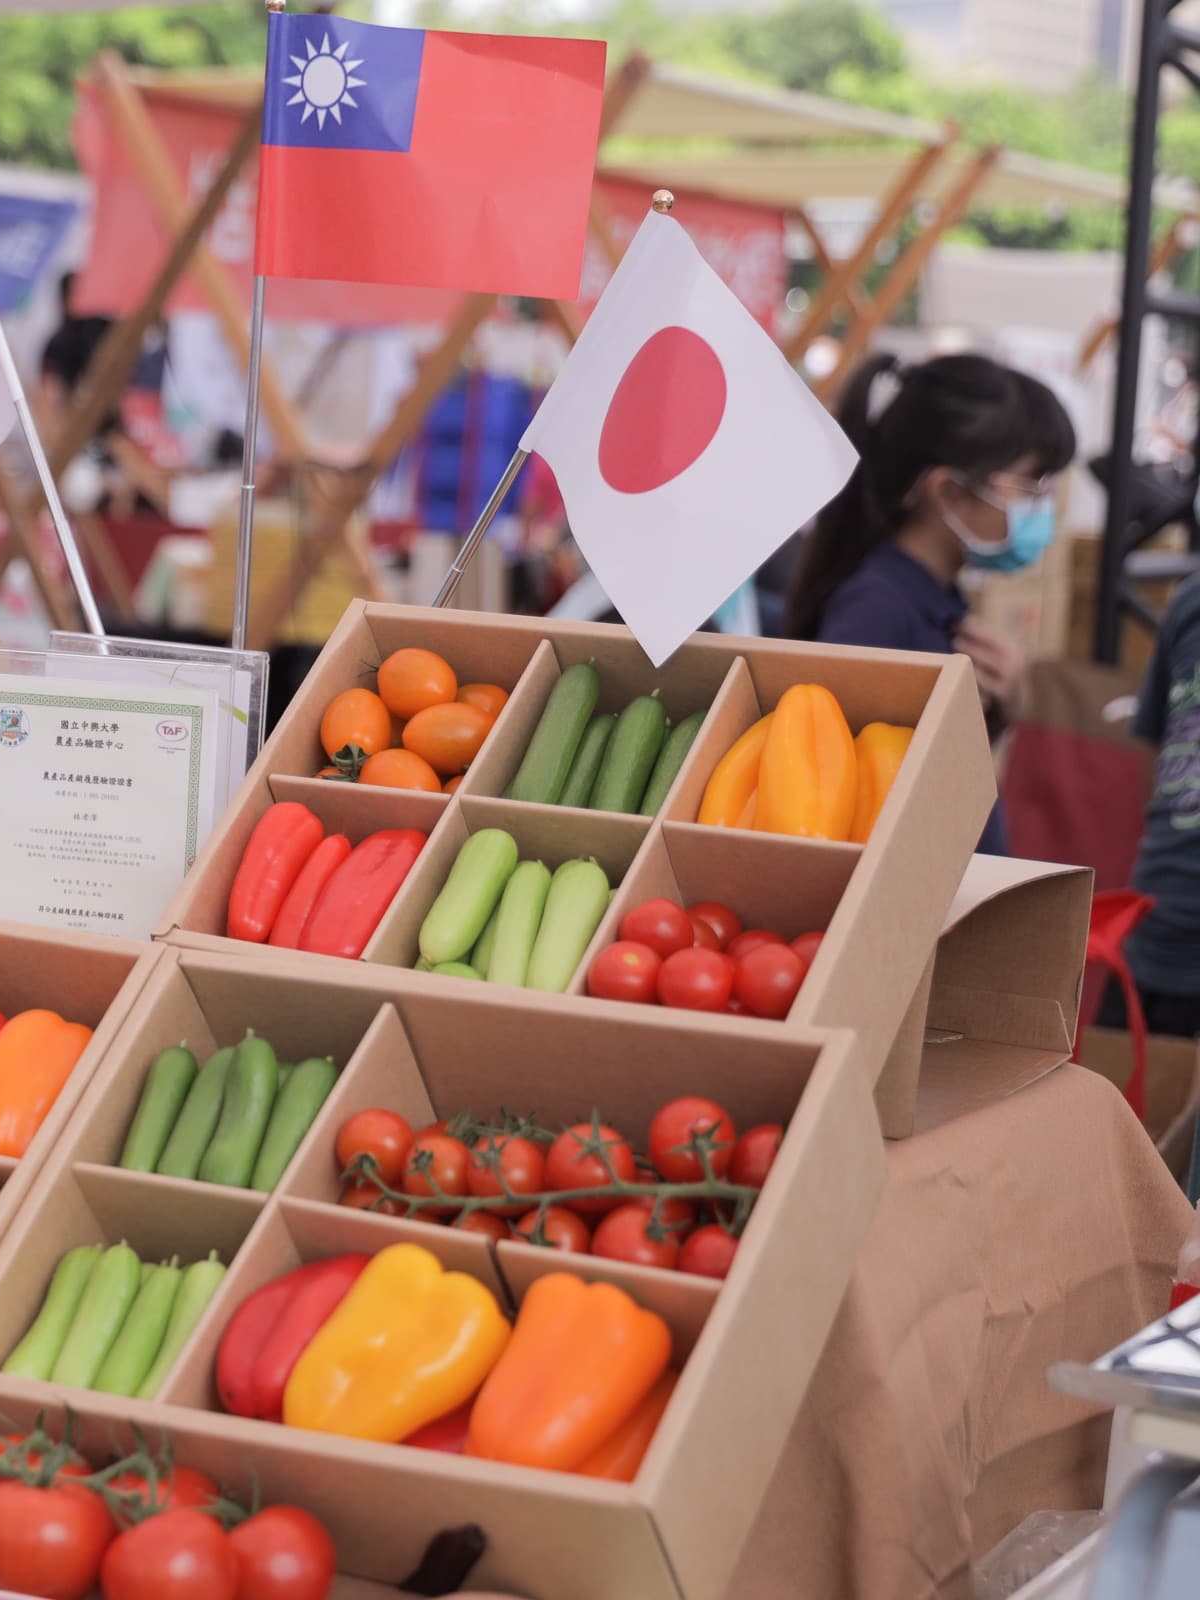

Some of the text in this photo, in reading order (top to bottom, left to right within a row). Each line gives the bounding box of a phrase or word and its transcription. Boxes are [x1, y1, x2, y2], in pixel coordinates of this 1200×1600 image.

[60, 719, 120, 734] 國立中興大學
[161, 725, 183, 737] TAF
[55, 735, 124, 750] 農產品驗證中心
